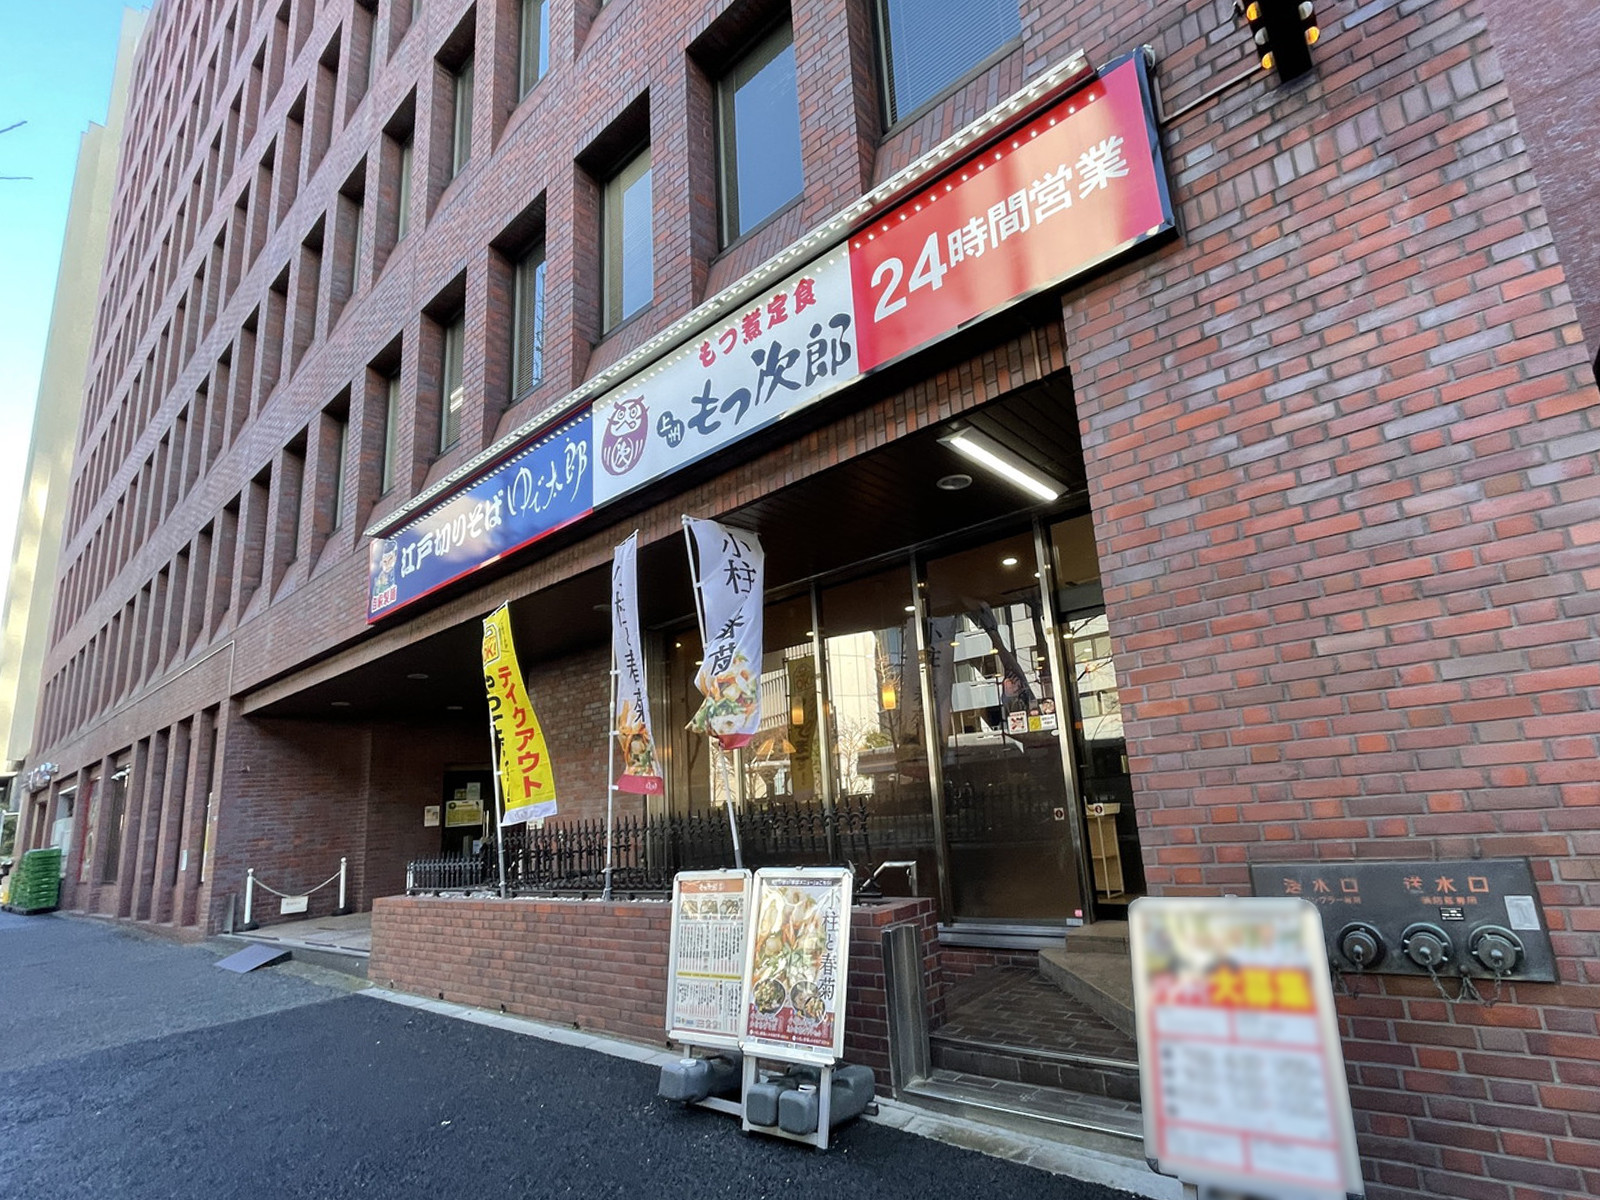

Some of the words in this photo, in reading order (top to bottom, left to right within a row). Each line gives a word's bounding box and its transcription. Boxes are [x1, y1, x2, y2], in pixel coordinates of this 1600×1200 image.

[871, 136, 1130, 323] 24時間営業
[688, 313, 852, 435] もつ次郎
[698, 278, 816, 367] もつ煮定食
[498, 665, 542, 798] テイクアウト
[1403, 876, 1490, 894] 送水口
[817, 888, 841, 1001] 小柱と春菊
